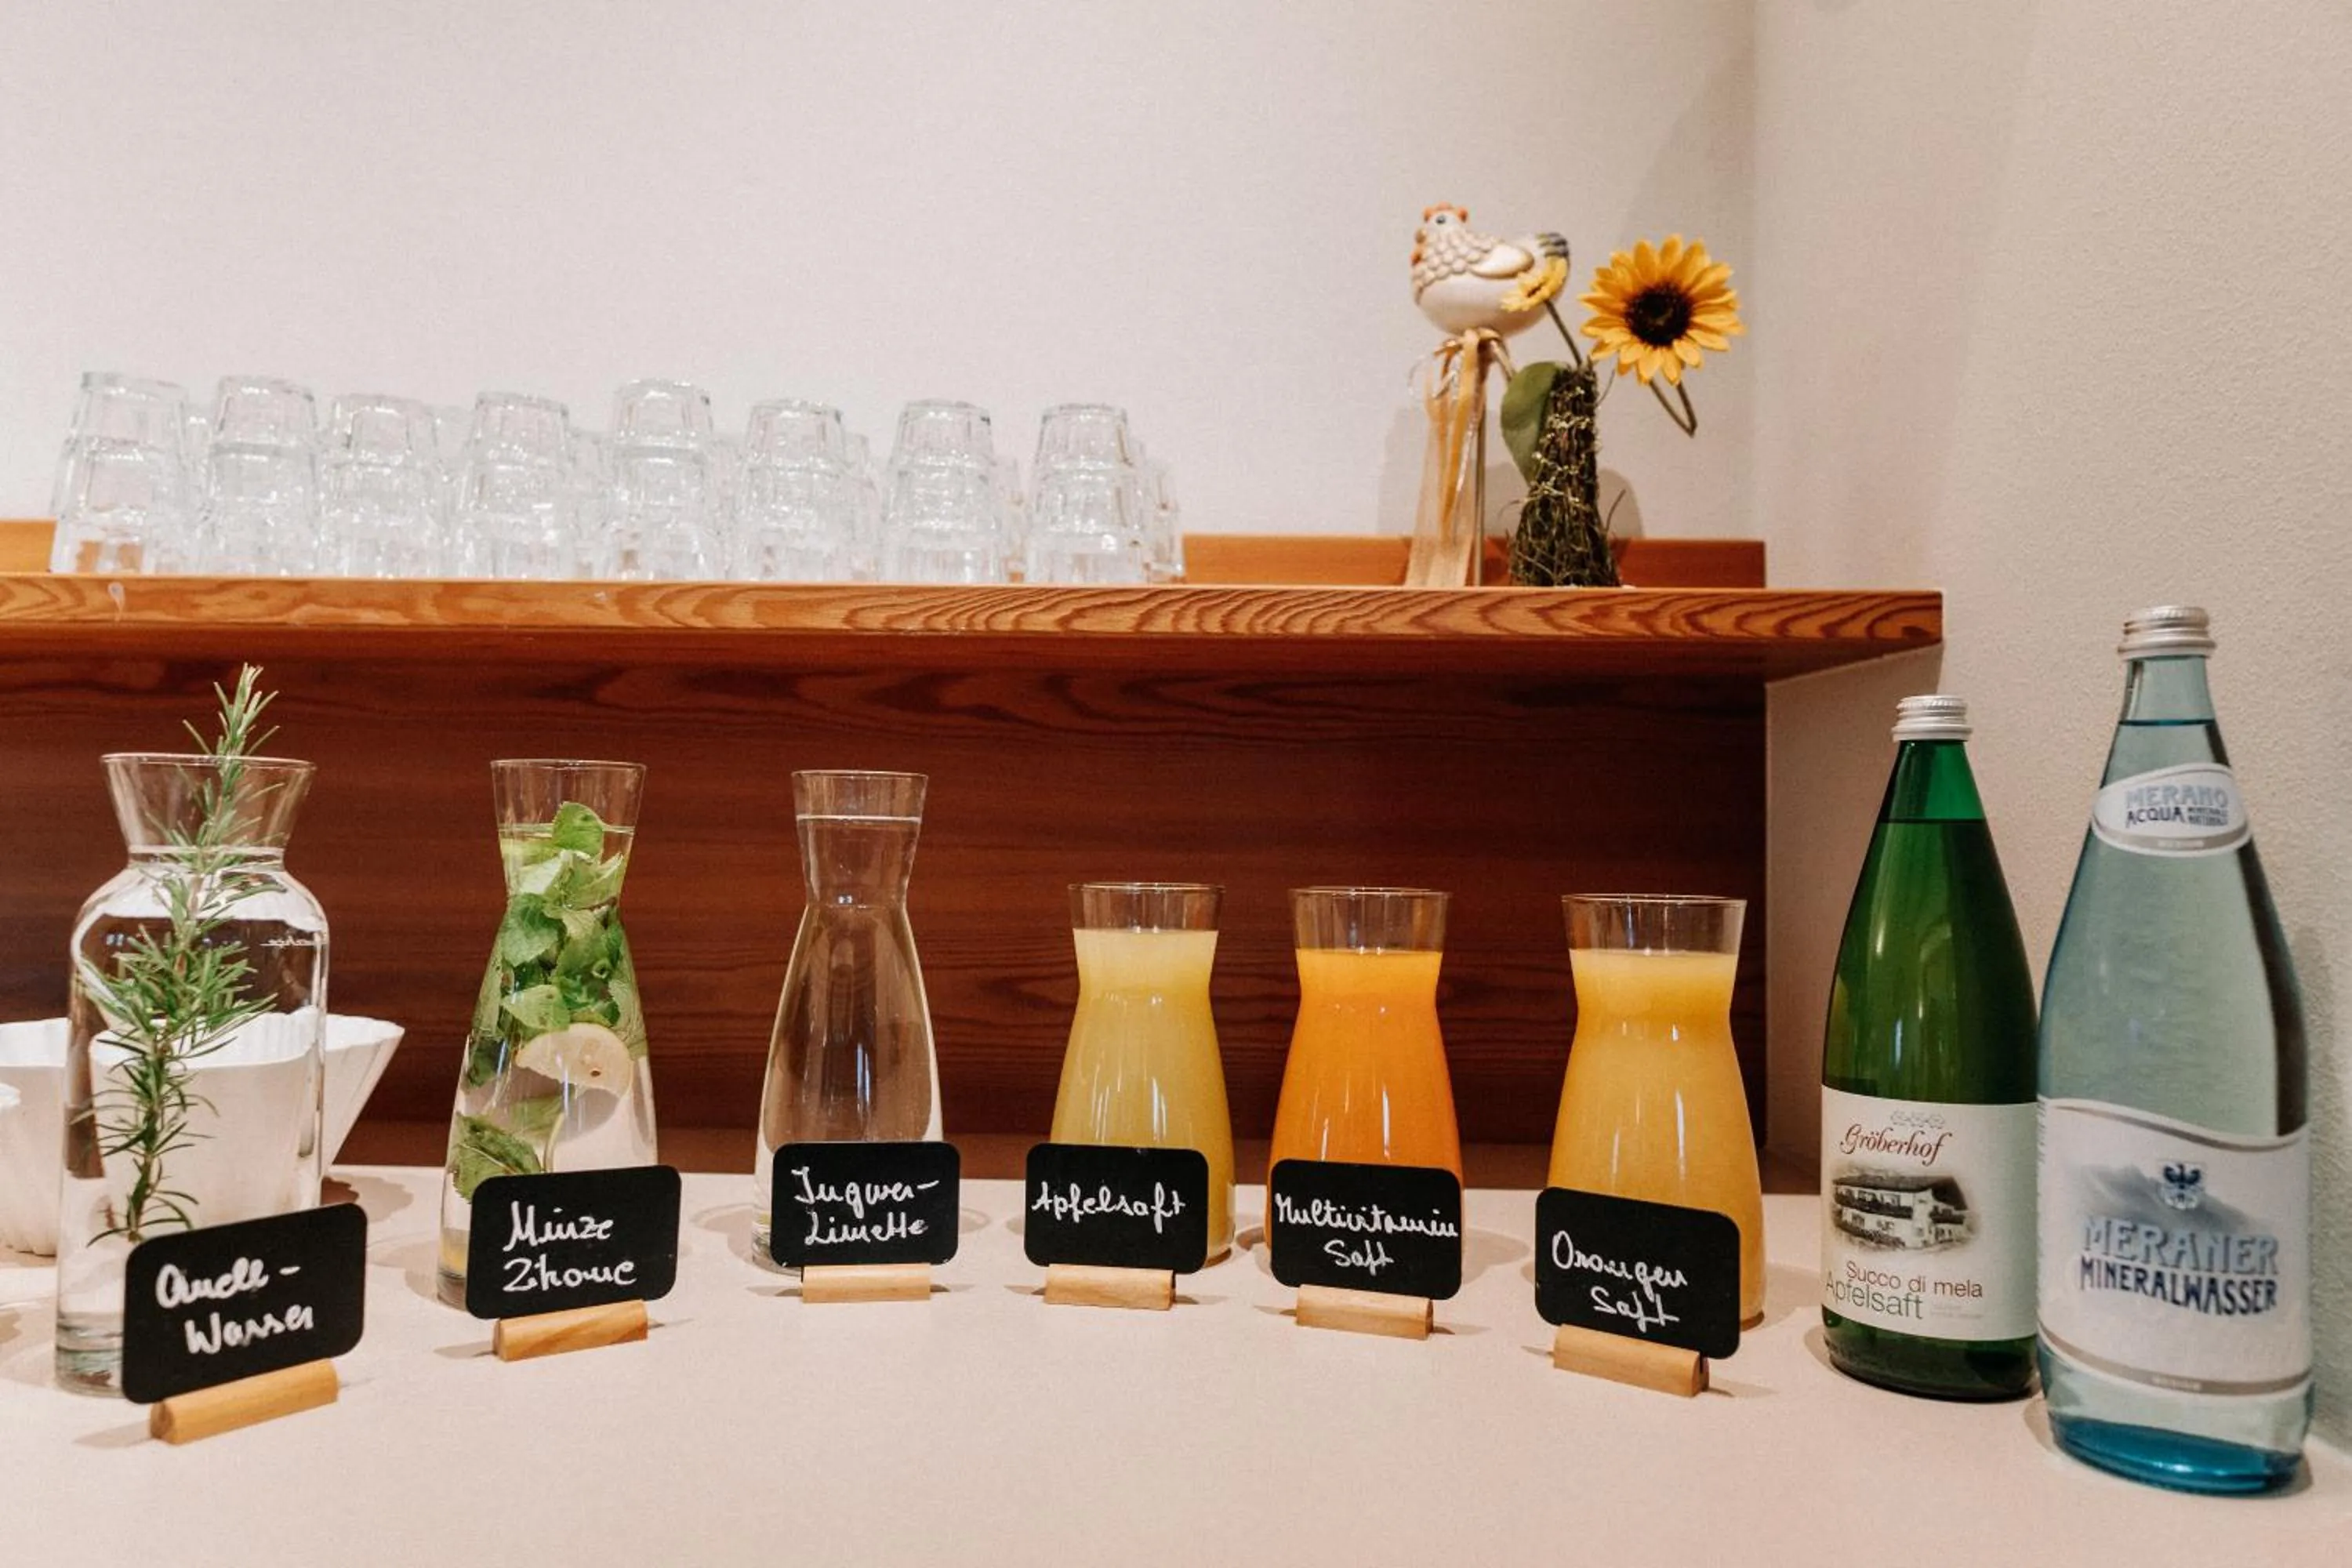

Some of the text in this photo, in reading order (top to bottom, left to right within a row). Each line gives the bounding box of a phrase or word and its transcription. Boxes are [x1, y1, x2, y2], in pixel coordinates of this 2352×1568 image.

[2125, 785, 2229, 808] MERANO
[2126, 807, 2184, 828] ACQUA
[1840, 1123, 1953, 1167] Gröberhof
[503, 1200, 614, 1252] Minze
[804, 1211, 927, 1246] Limette
[1031, 1181, 1185, 1233] Apfelsaft
[1275, 1192, 1458, 1237] Multivitamin
[1323, 1239, 1394, 1276] Saft
[1552, 1230, 1688, 1302] Orangen
[2083, 1218, 2280, 1276] MERANER
[1825, 1270, 1923, 1319] Apfelsaft
[1846, 1261, 1983, 1298] Succo di mela
[2080, 1256, 2278, 1316] MINERALWASSER
[184, 1305, 314, 1354] Wasser
[1591, 1286, 1679, 1333] Saft
